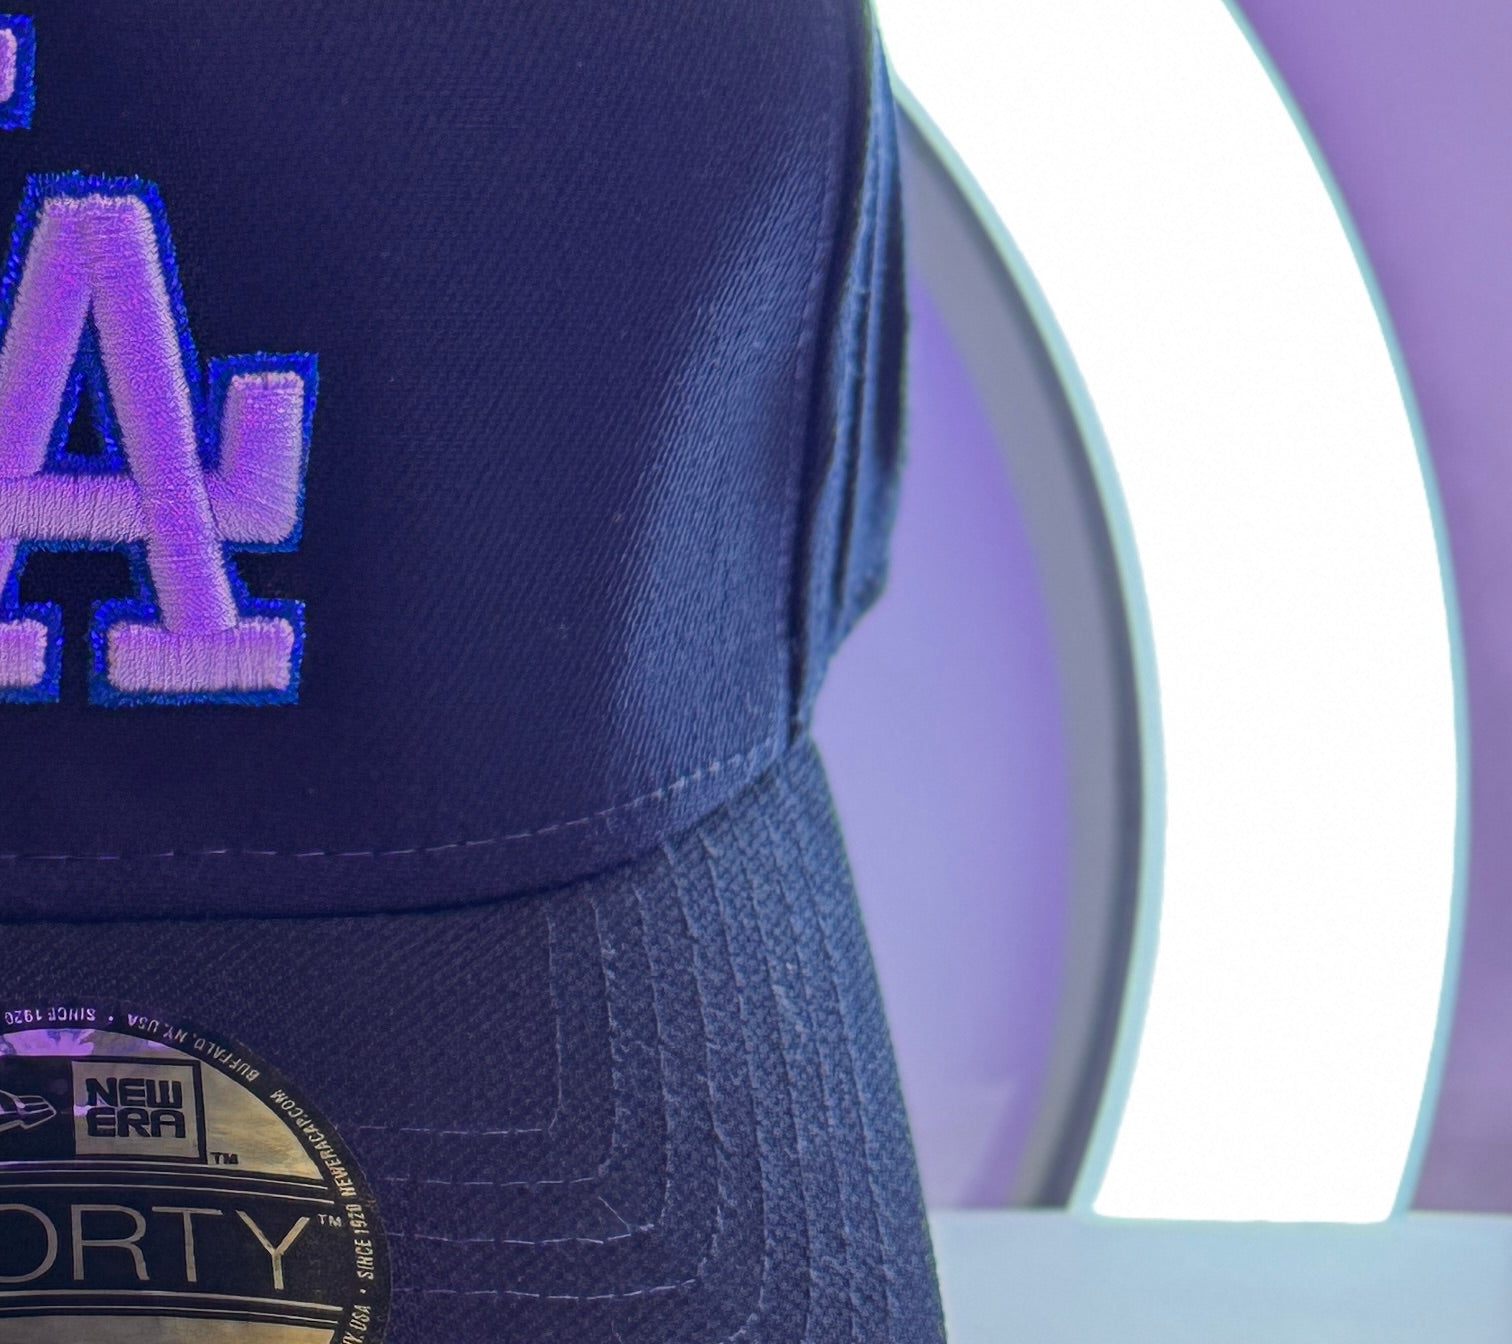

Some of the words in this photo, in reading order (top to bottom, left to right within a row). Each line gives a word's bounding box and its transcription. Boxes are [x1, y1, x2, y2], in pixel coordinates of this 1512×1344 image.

[4, 1009, 43, 1026] 1920
[48, 1007, 97, 1023] SINCE
[128, 1013, 160, 1034] USA
[85, 1077, 183, 1109] NEW
[87, 1106, 186, 1138] ERA
[346, 1203, 370, 1234] 1920
[354, 1239, 374, 1280] SINCE
[349, 1304, 372, 1332] USA
